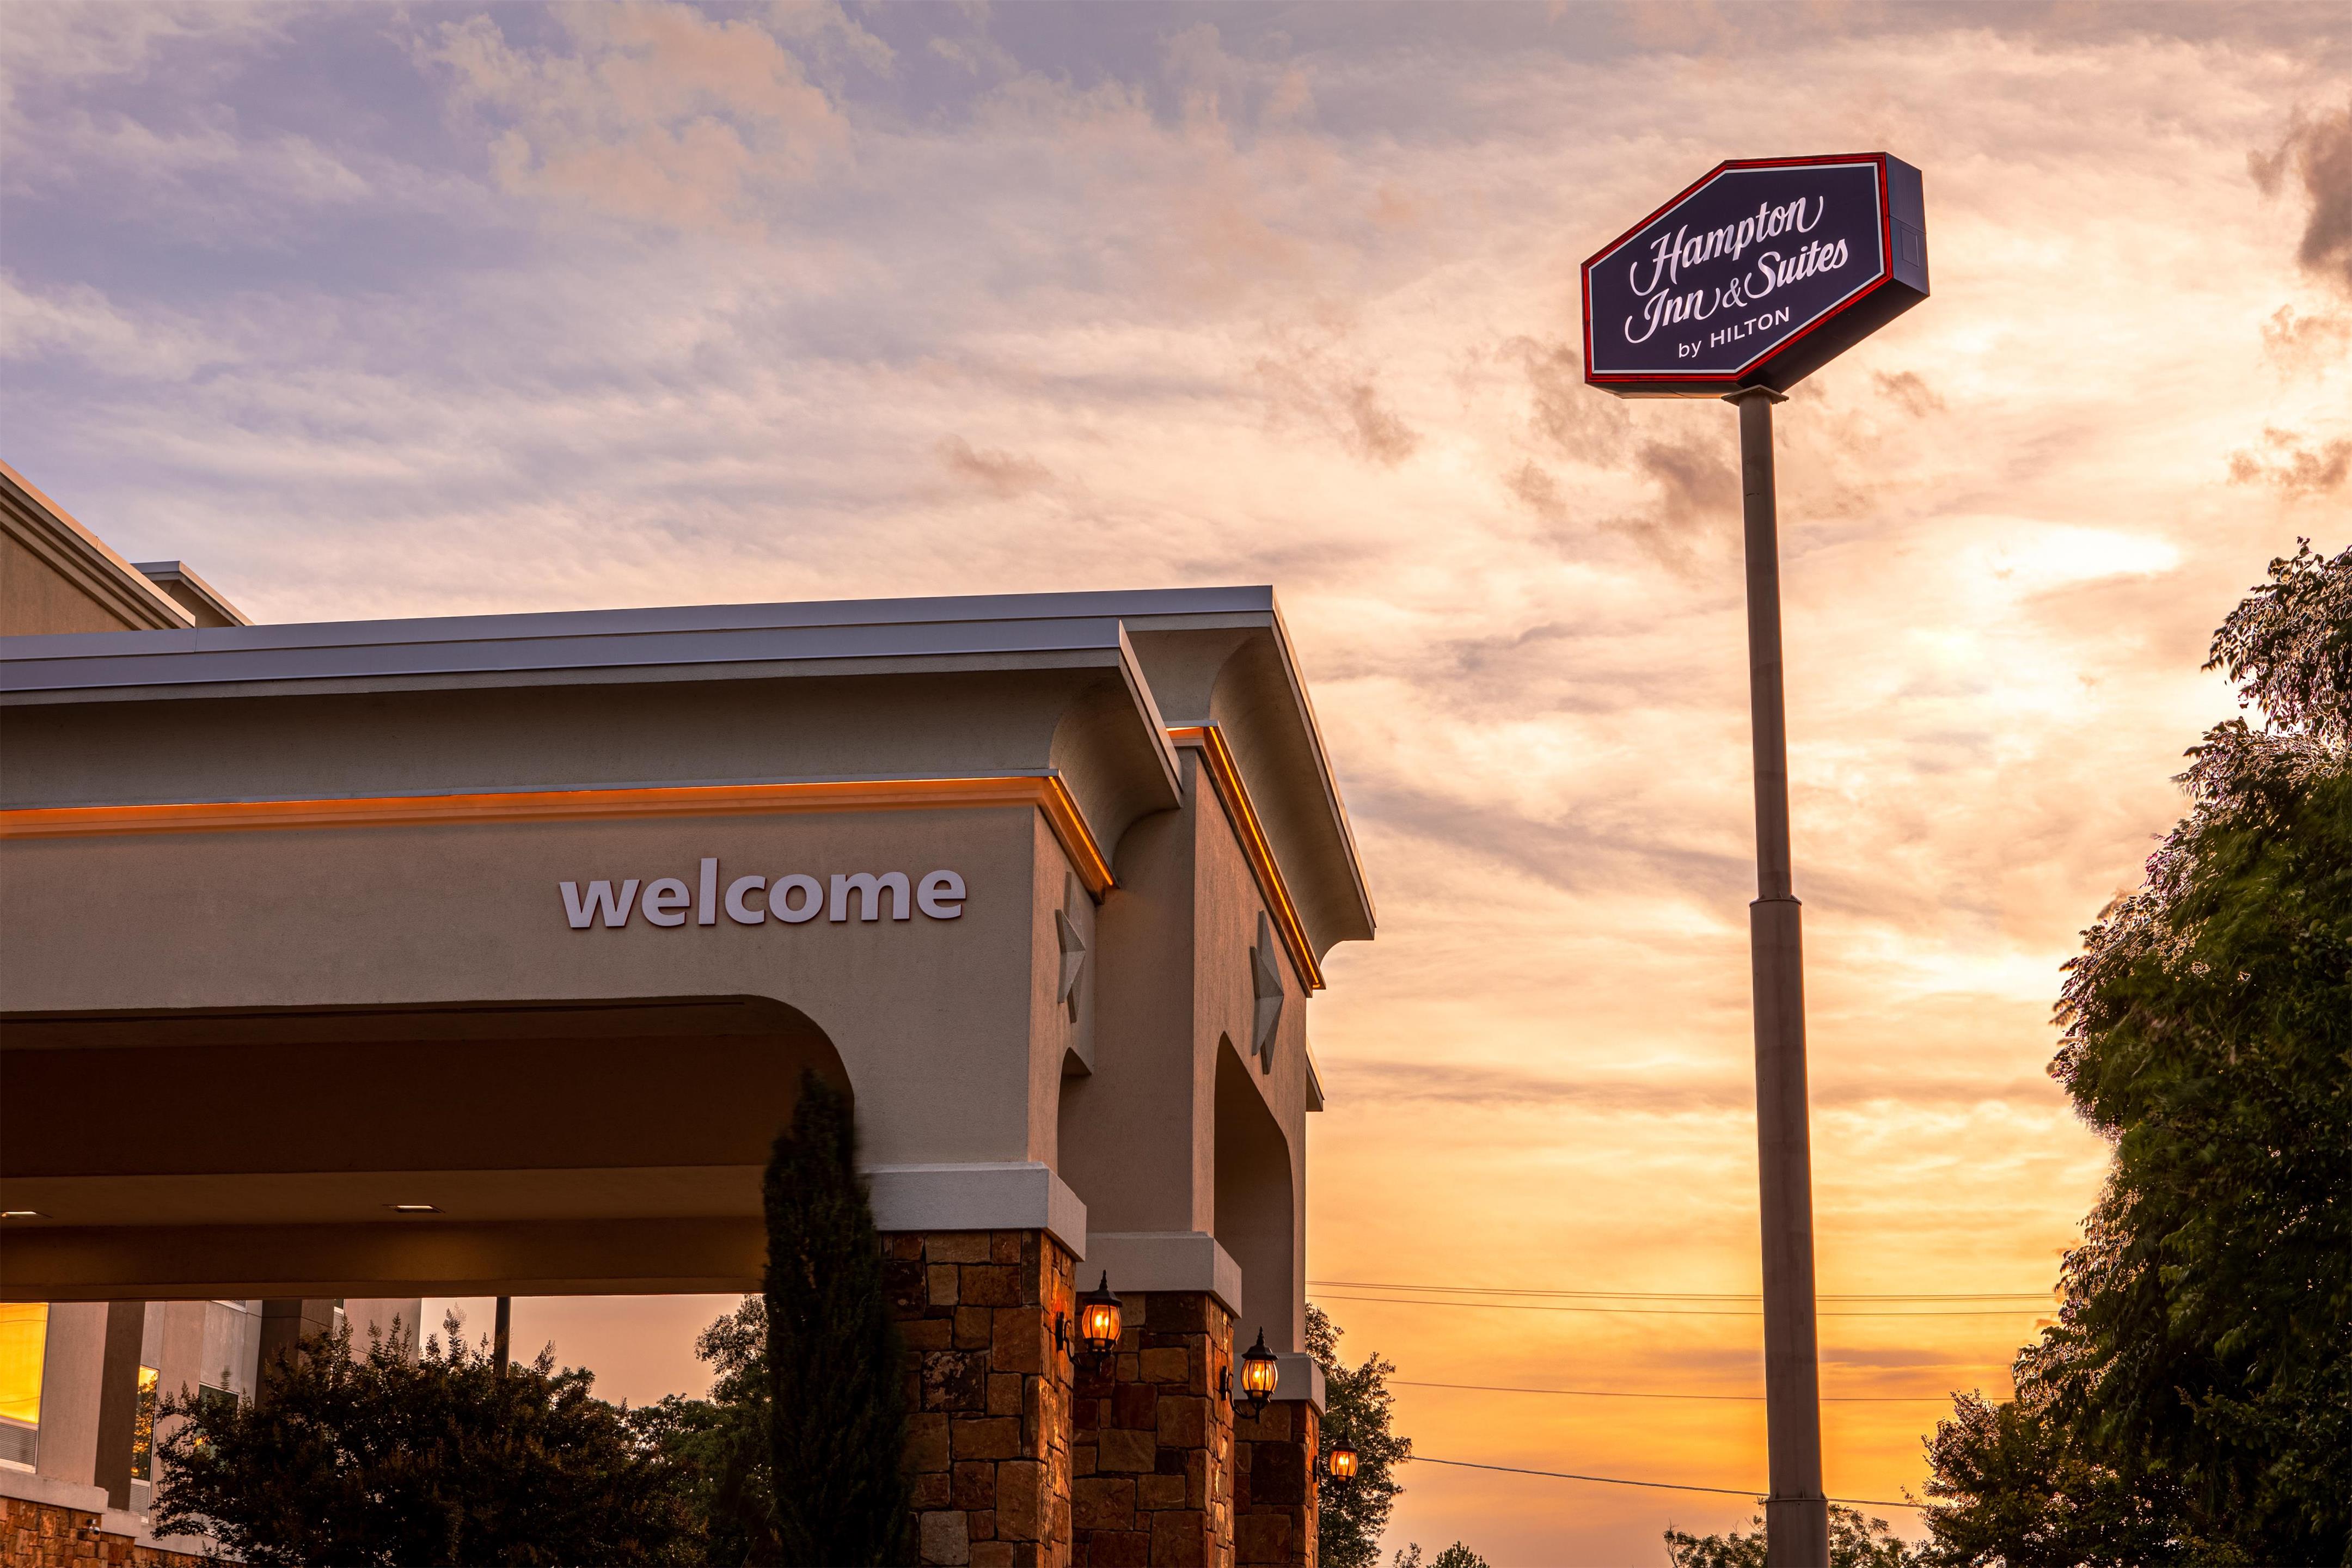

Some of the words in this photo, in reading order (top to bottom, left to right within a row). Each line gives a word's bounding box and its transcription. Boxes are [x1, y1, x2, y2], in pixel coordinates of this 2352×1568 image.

[1630, 195, 1824, 296] Hampton
[1624, 287, 1721, 344] Inn
[1722, 277, 1748, 308] &
[1744, 238, 1848, 299] Suites
[1679, 340, 1702, 358] by
[1710, 307, 1789, 348] HILTON
[559, 857, 966, 928] welcome
